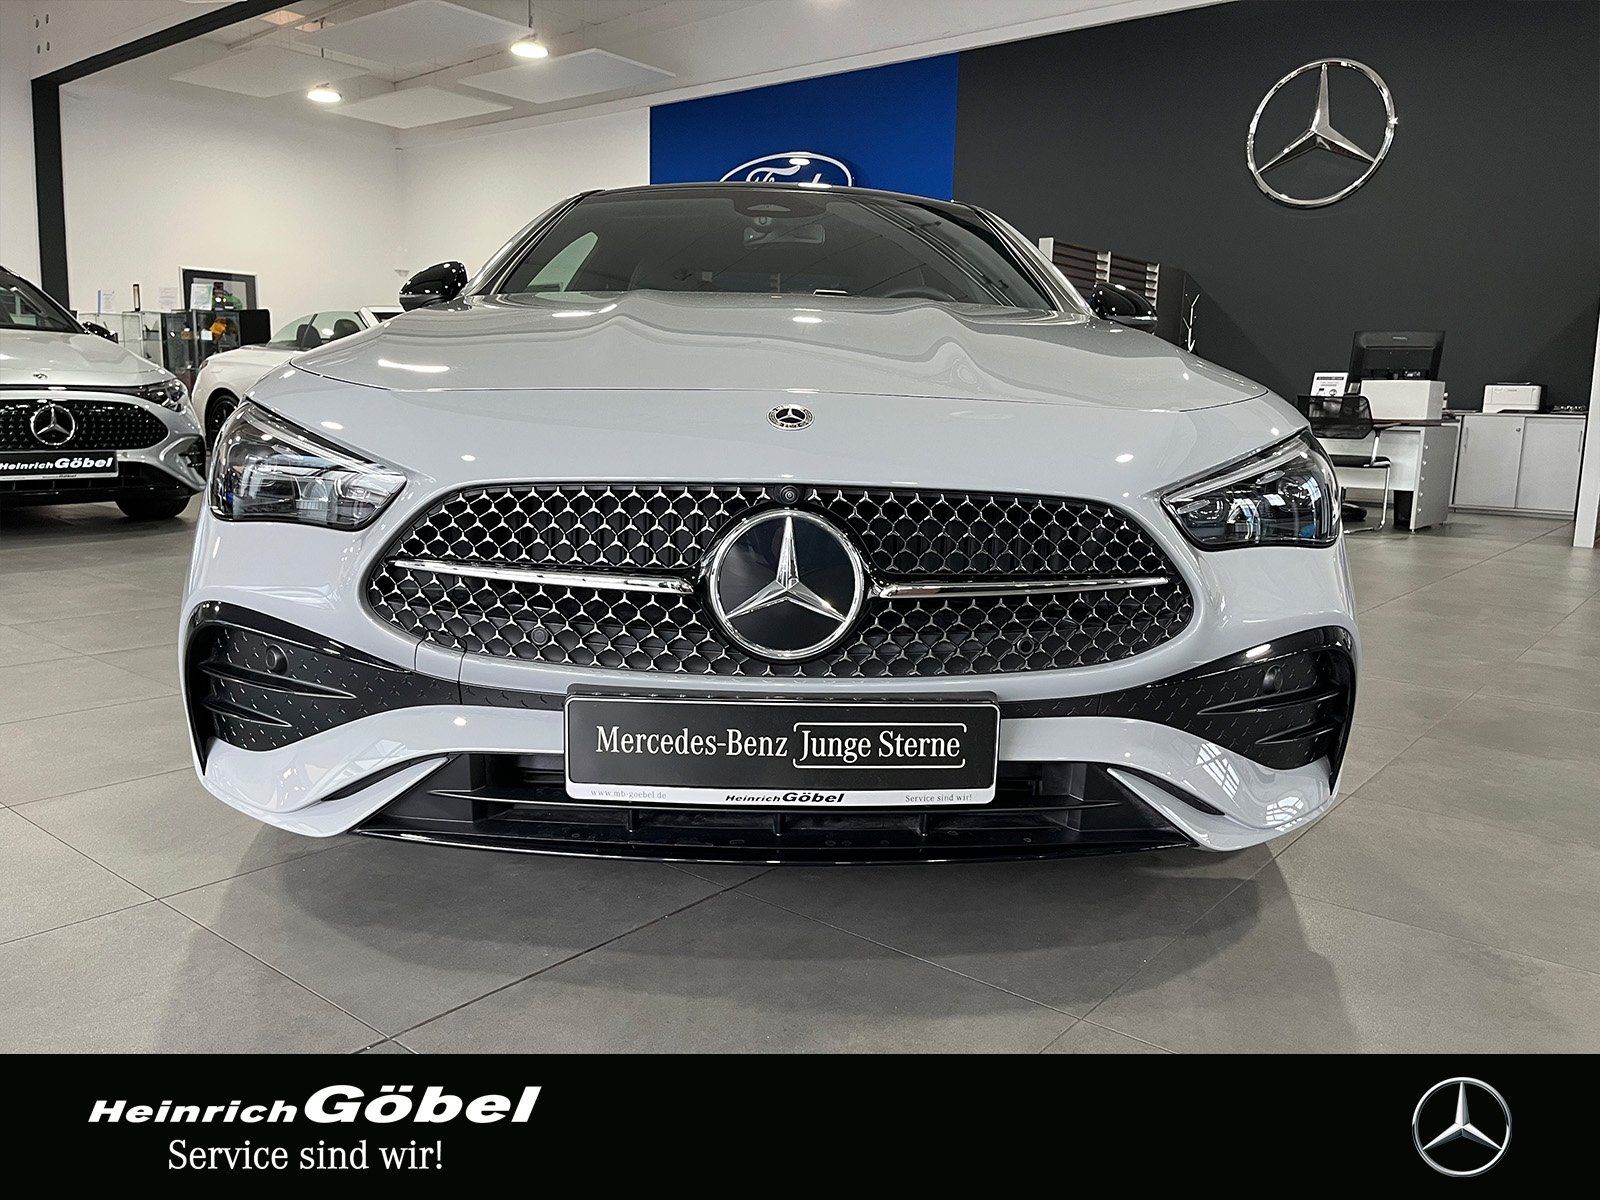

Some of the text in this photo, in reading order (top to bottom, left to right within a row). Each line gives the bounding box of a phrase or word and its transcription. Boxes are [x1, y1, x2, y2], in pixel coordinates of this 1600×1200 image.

[0, 457, 114, 470] Heinrich Göbel
[595, 725, 961, 764] Mercedes-Benz Junge Sterne
[590, 789, 667, 799] www.mb-goebel.de
[725, 792, 845, 803] Heinrich Göbel
[905, 793, 972, 802] Service sind wir!
